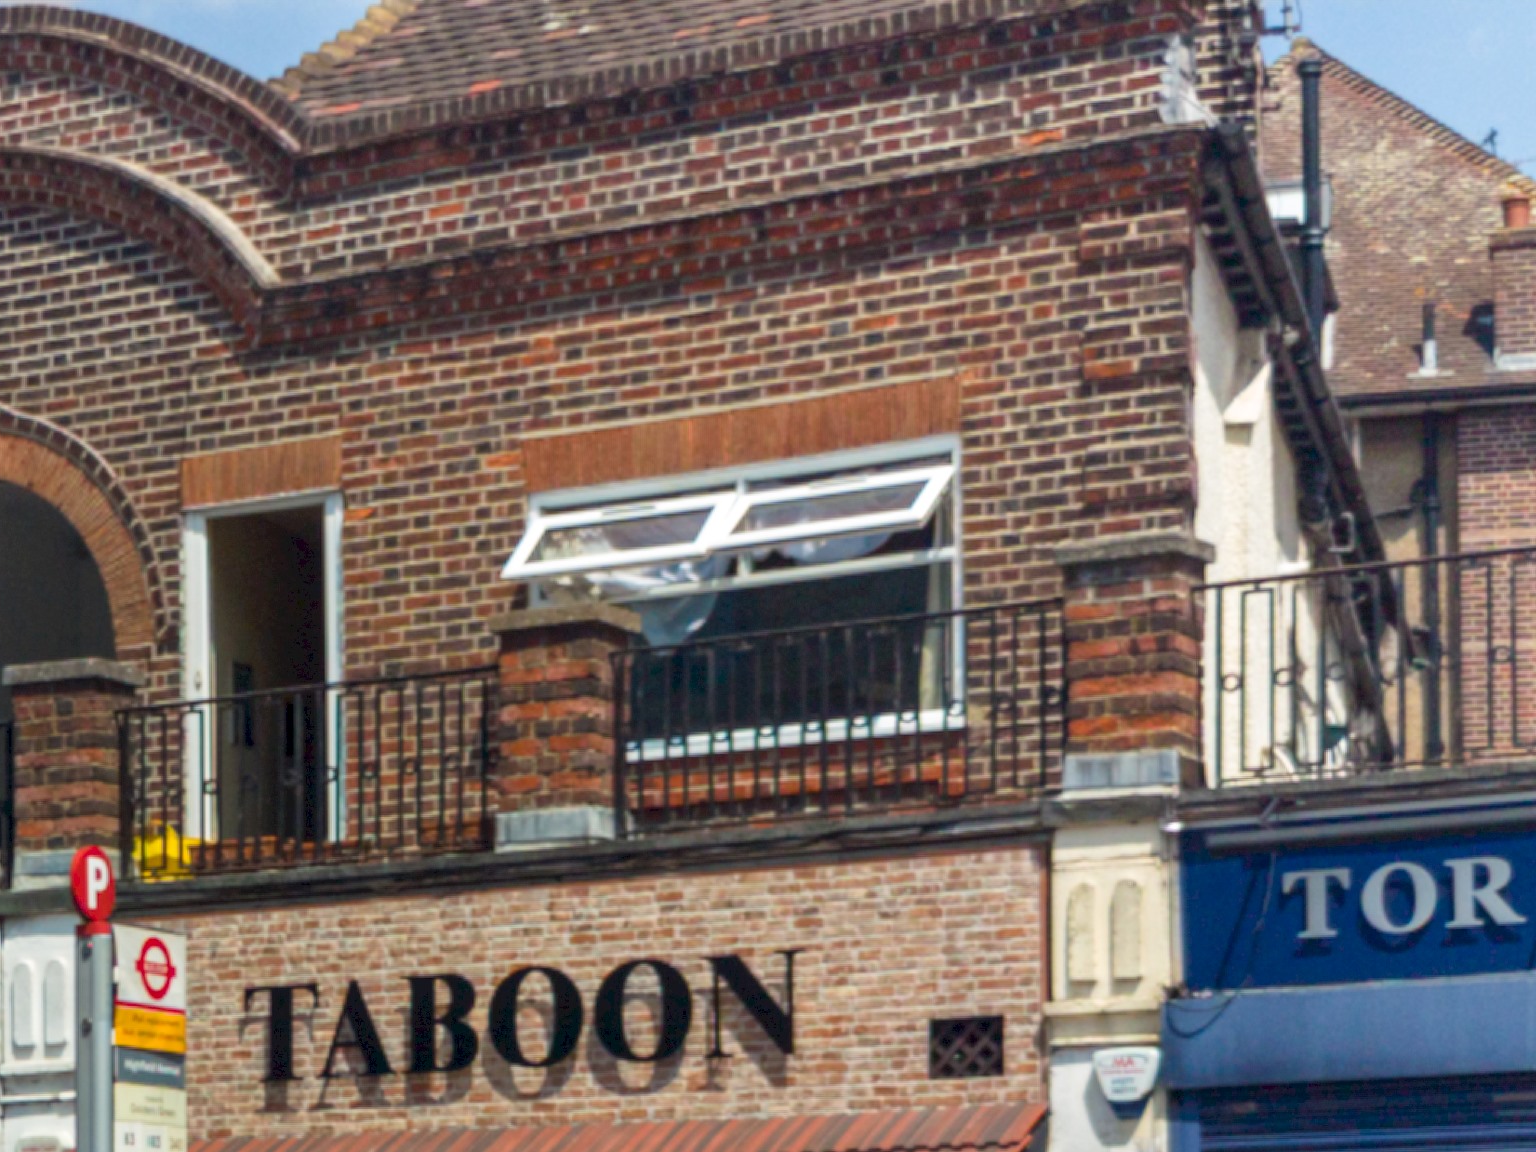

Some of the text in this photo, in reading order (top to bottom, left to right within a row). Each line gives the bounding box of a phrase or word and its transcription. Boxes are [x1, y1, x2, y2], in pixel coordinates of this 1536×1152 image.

[86, 856, 110, 910] P
[1281, 856, 1528, 940] TOR
[244, 948, 806, 1084] TABOON
